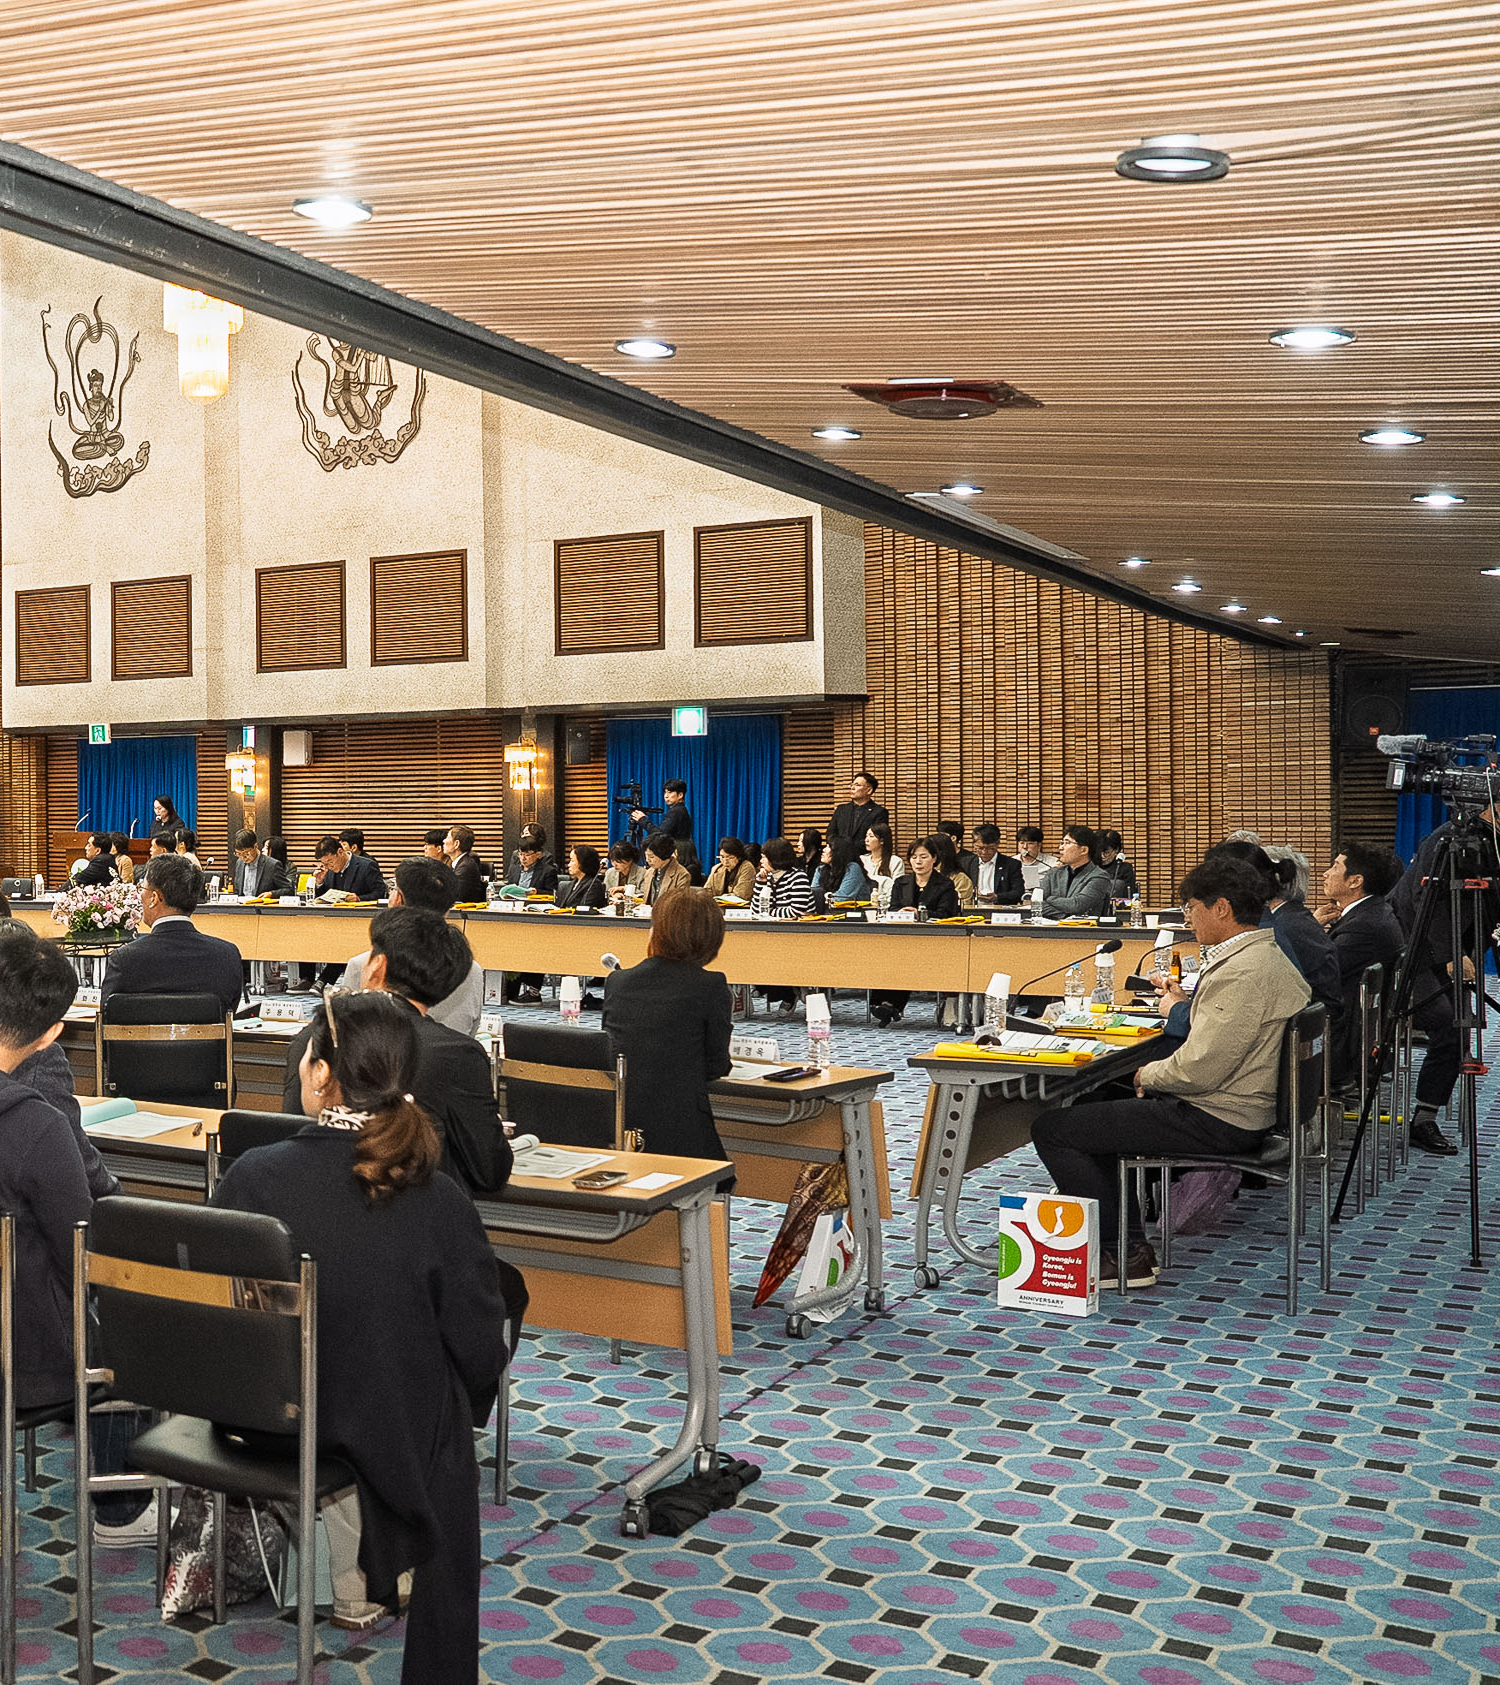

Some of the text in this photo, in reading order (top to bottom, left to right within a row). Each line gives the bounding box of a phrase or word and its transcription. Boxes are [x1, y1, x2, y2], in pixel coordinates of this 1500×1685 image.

[1042, 1254, 1083, 1265] Gyeongju is
[1042, 1261, 1065, 1271] Korea,
[1042, 1271, 1074, 1281] Bomun is
[1042, 1279, 1078, 1289] Gyeongju!
[1019, 1295, 1064, 1305] ANNIVERSARY
